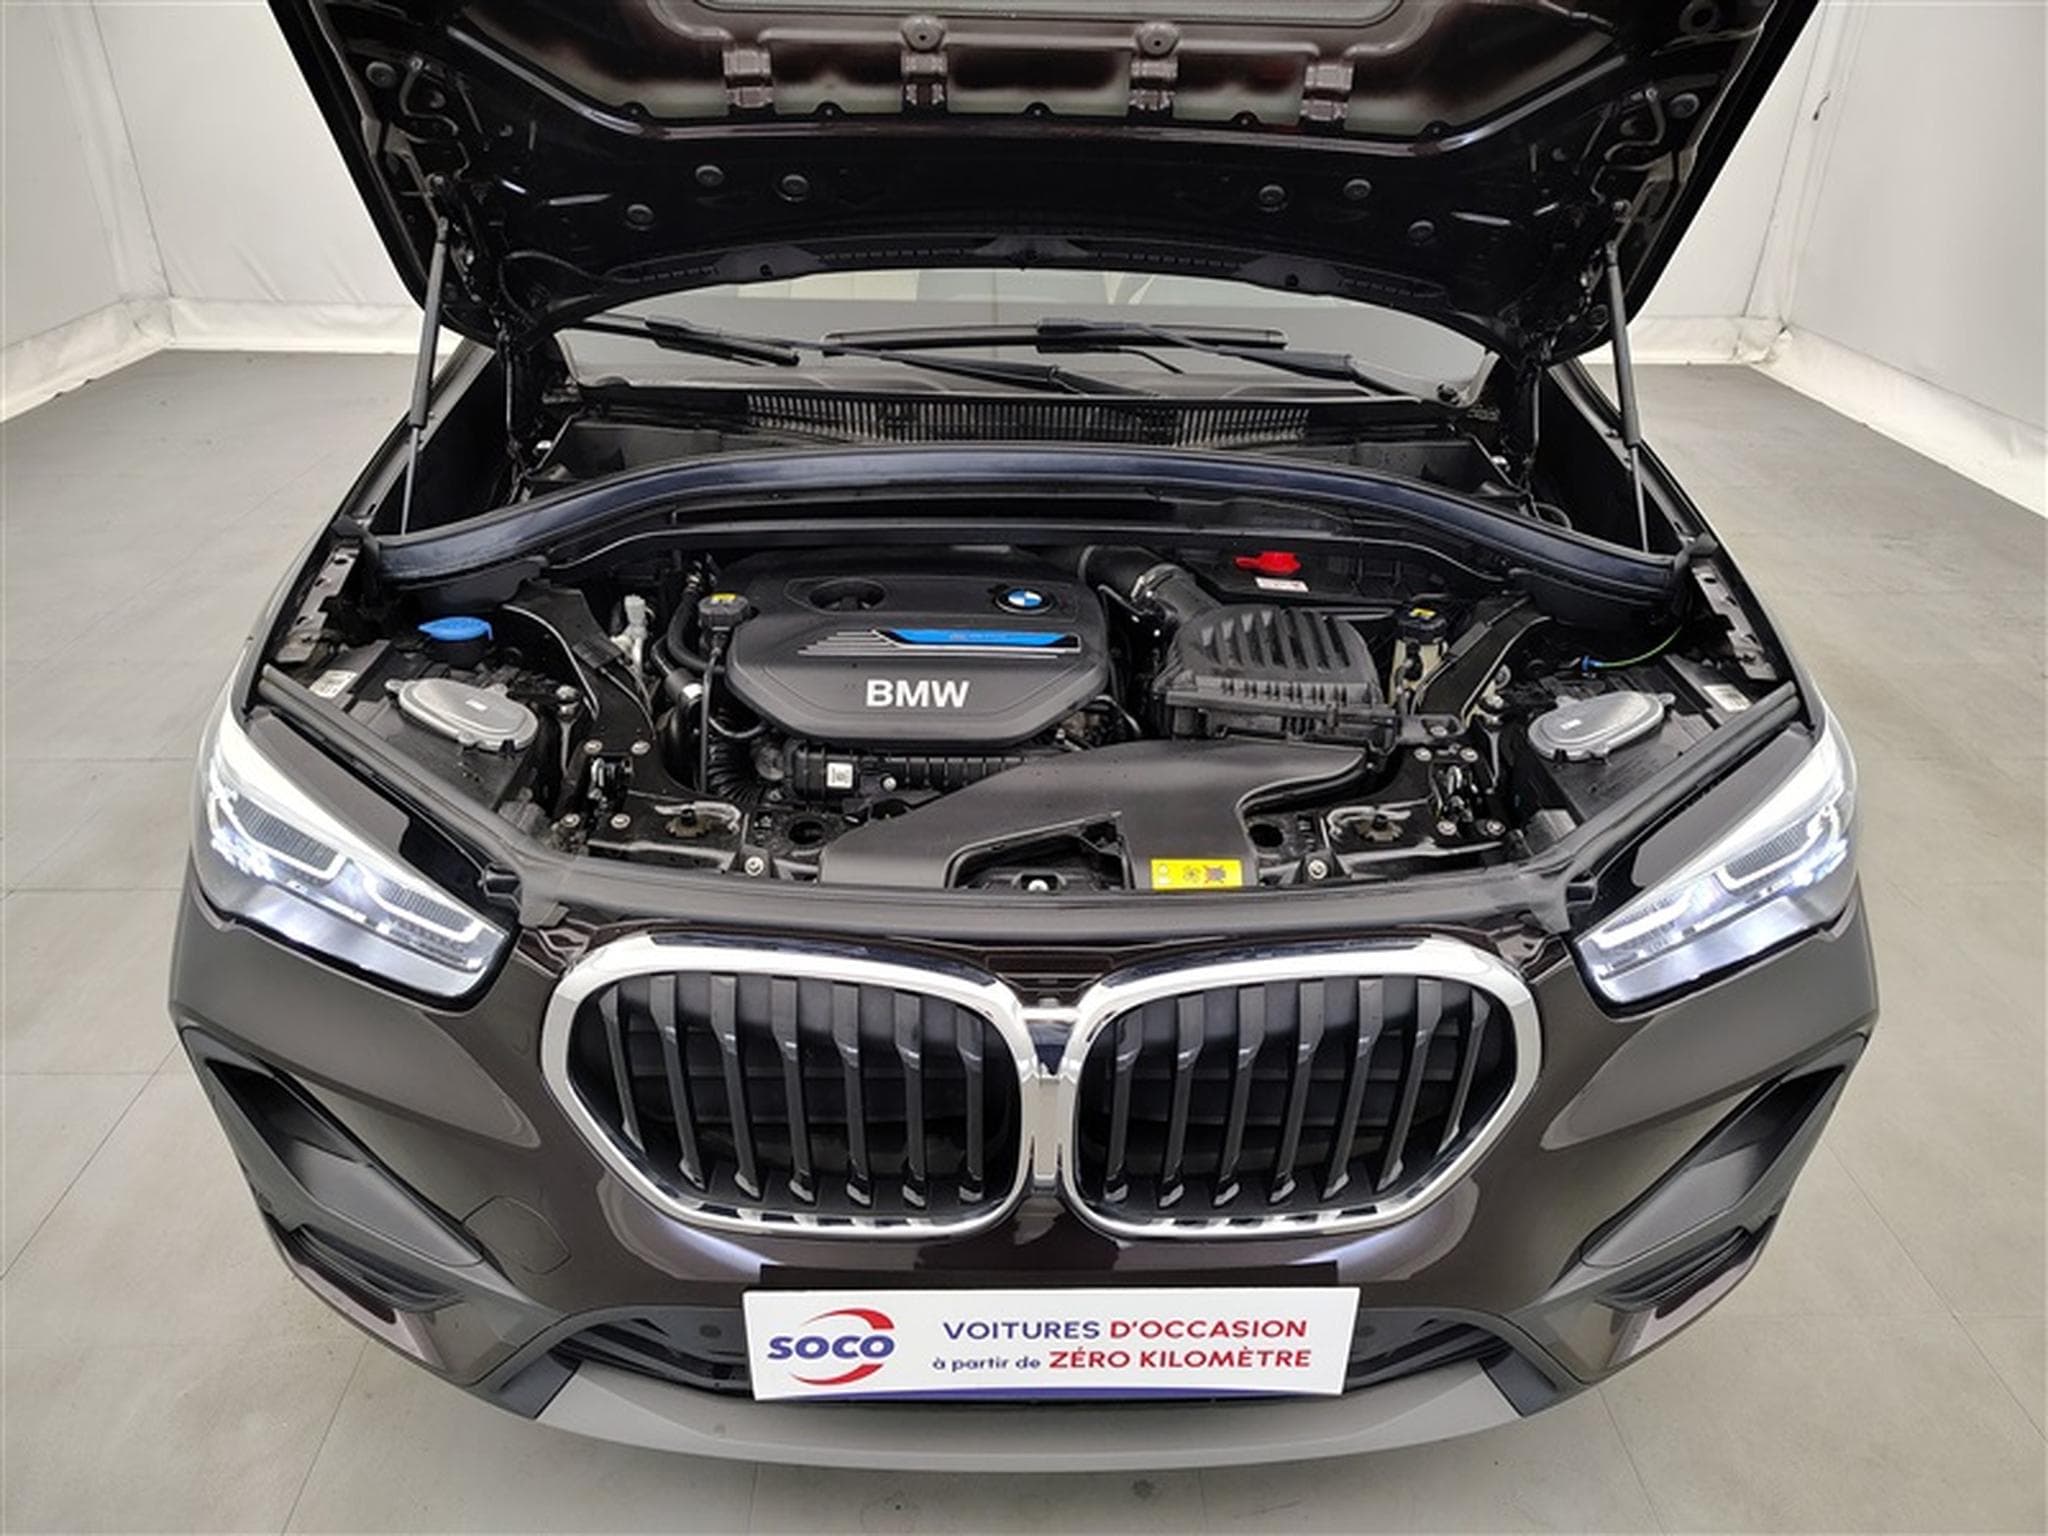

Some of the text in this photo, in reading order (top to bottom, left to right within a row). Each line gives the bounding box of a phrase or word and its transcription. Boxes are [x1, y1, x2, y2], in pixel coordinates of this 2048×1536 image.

[865, 679, 969, 708] BMW
[943, 1319, 1307, 1341] VOITURES D'OCCASION
[768, 1335, 895, 1360] SOCO
[932, 1346, 1311, 1373] à partir de ZÉRO KILOMÈTRE
